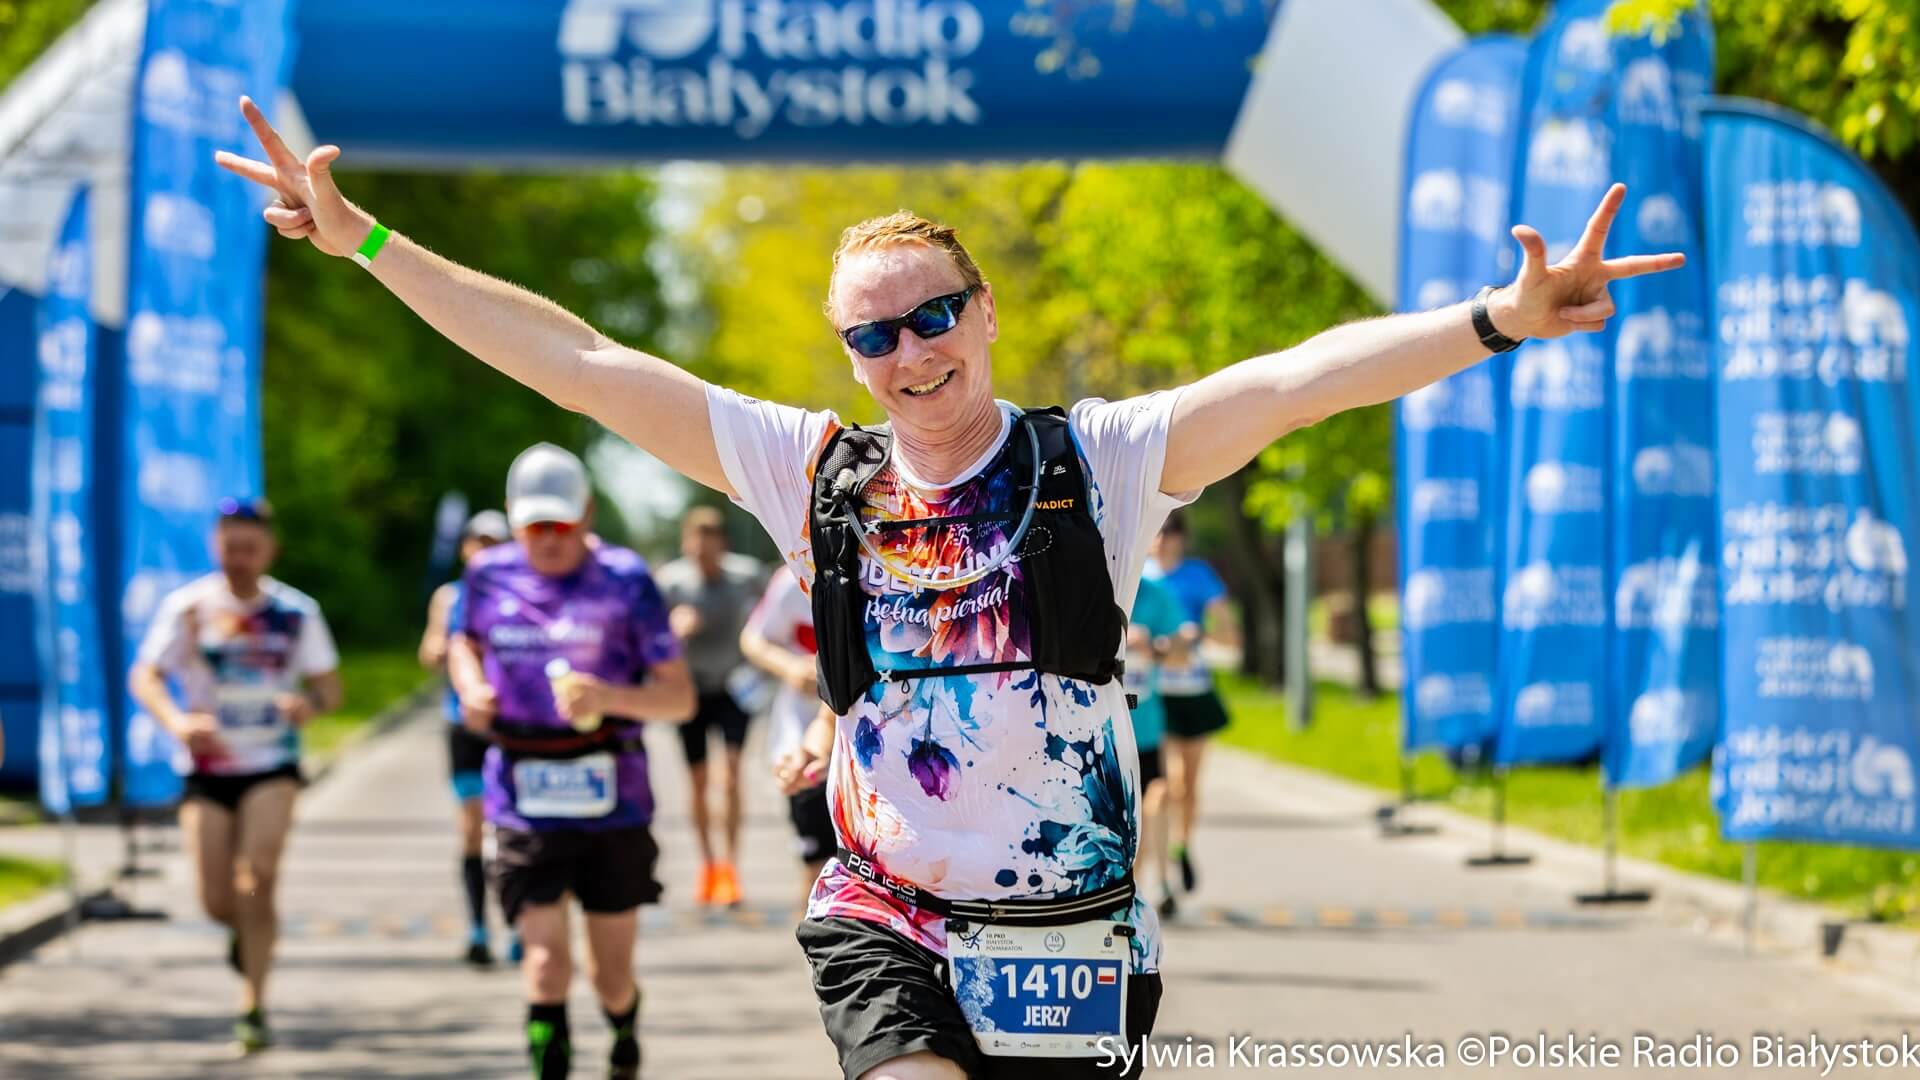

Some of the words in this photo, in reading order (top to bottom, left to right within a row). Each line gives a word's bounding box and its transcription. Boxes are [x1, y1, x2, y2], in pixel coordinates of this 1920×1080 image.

[717, 0, 983, 59] Radio
[1000, 964, 1092, 999] 1410
[1023, 1005, 1071, 1027] JERZY
